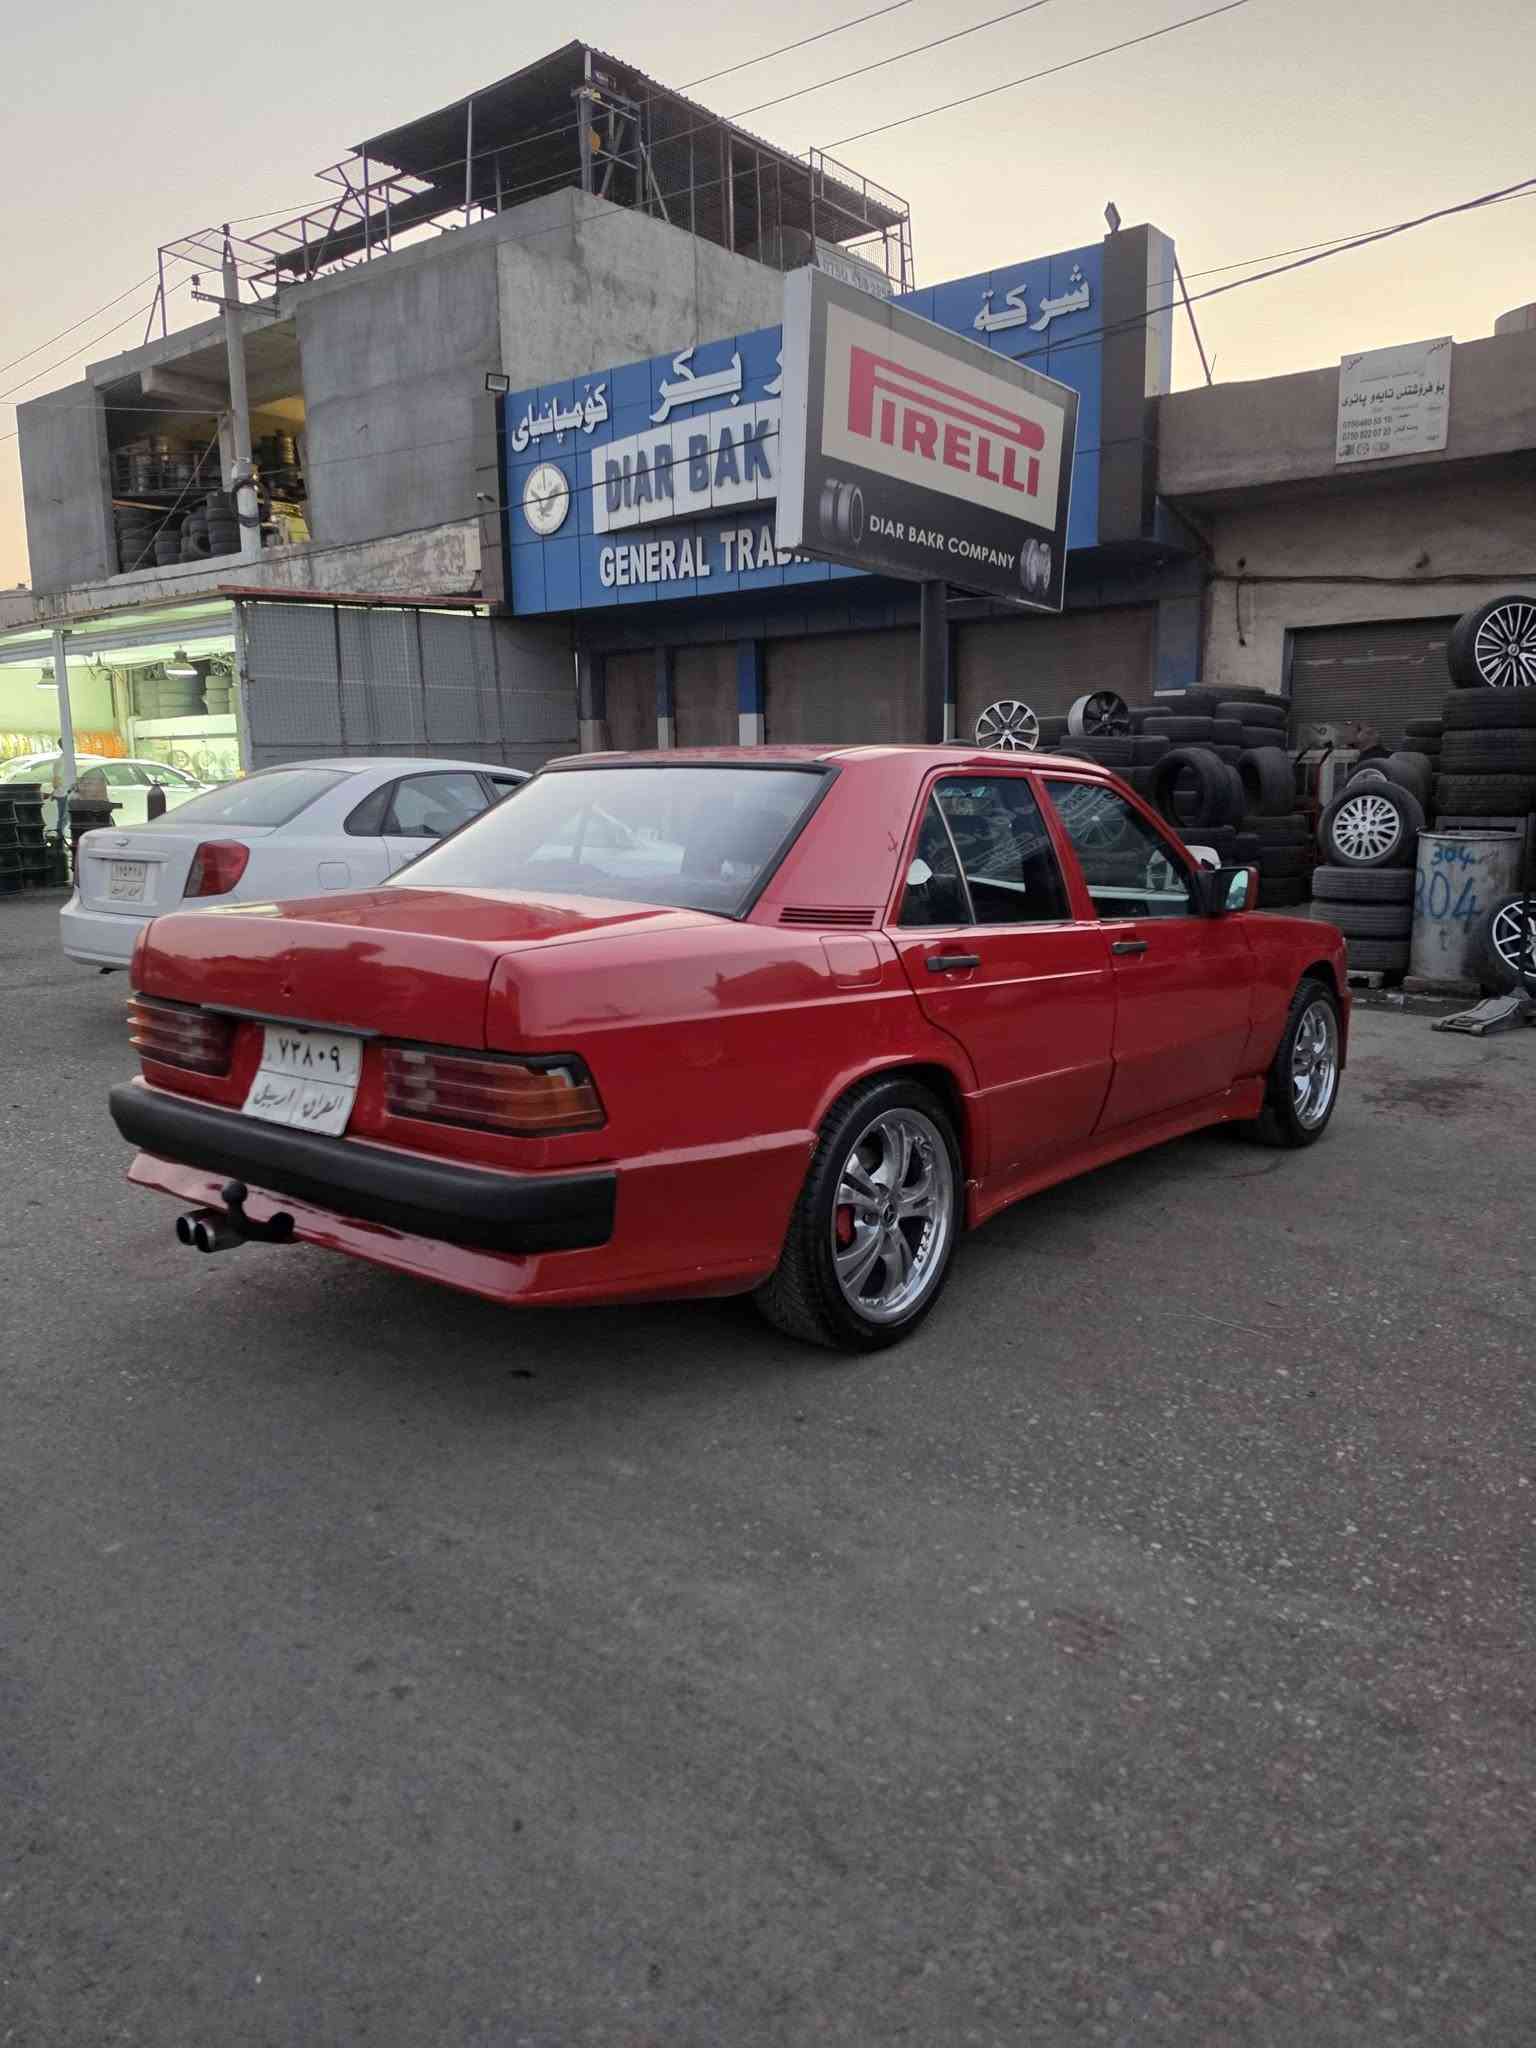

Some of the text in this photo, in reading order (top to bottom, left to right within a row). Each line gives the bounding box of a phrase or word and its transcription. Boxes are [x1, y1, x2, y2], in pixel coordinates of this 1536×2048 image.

[974, 264, 1090, 332] شركة
[848, 344, 1045, 497] PIRELLI
[605, 419, 781, 513] DIAR BAK
[600, 536, 710, 587] GENERAL
[870, 515, 1015, 570] DIAR BAKR COMPANY
[1431, 841, 1475, 871] 304
